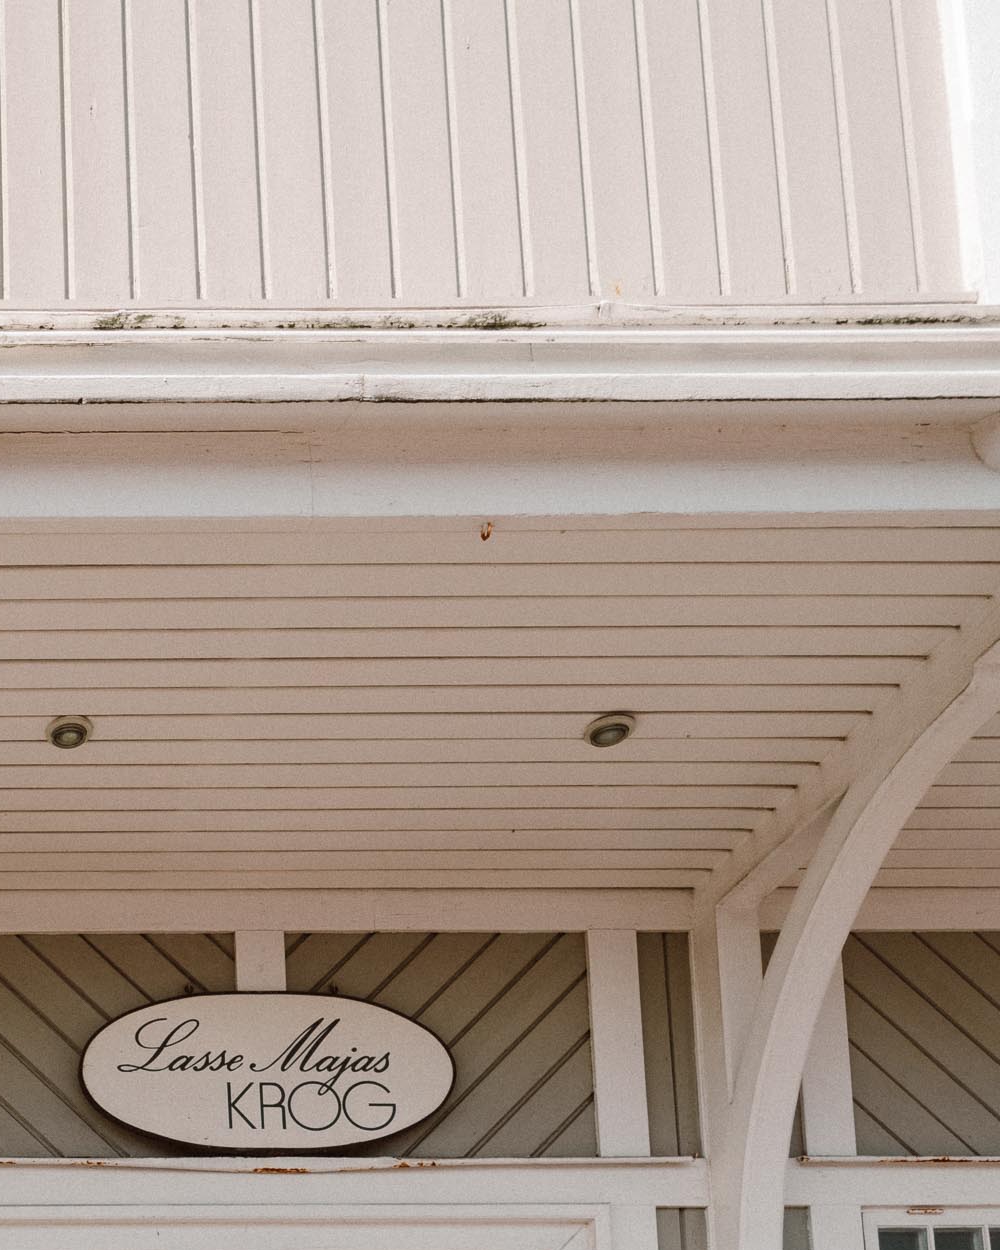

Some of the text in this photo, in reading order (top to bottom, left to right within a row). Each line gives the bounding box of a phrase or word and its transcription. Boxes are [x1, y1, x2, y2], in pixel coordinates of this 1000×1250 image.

[117, 1017, 390, 1096] Lasse Majas
[226, 1080, 397, 1131] KROG
